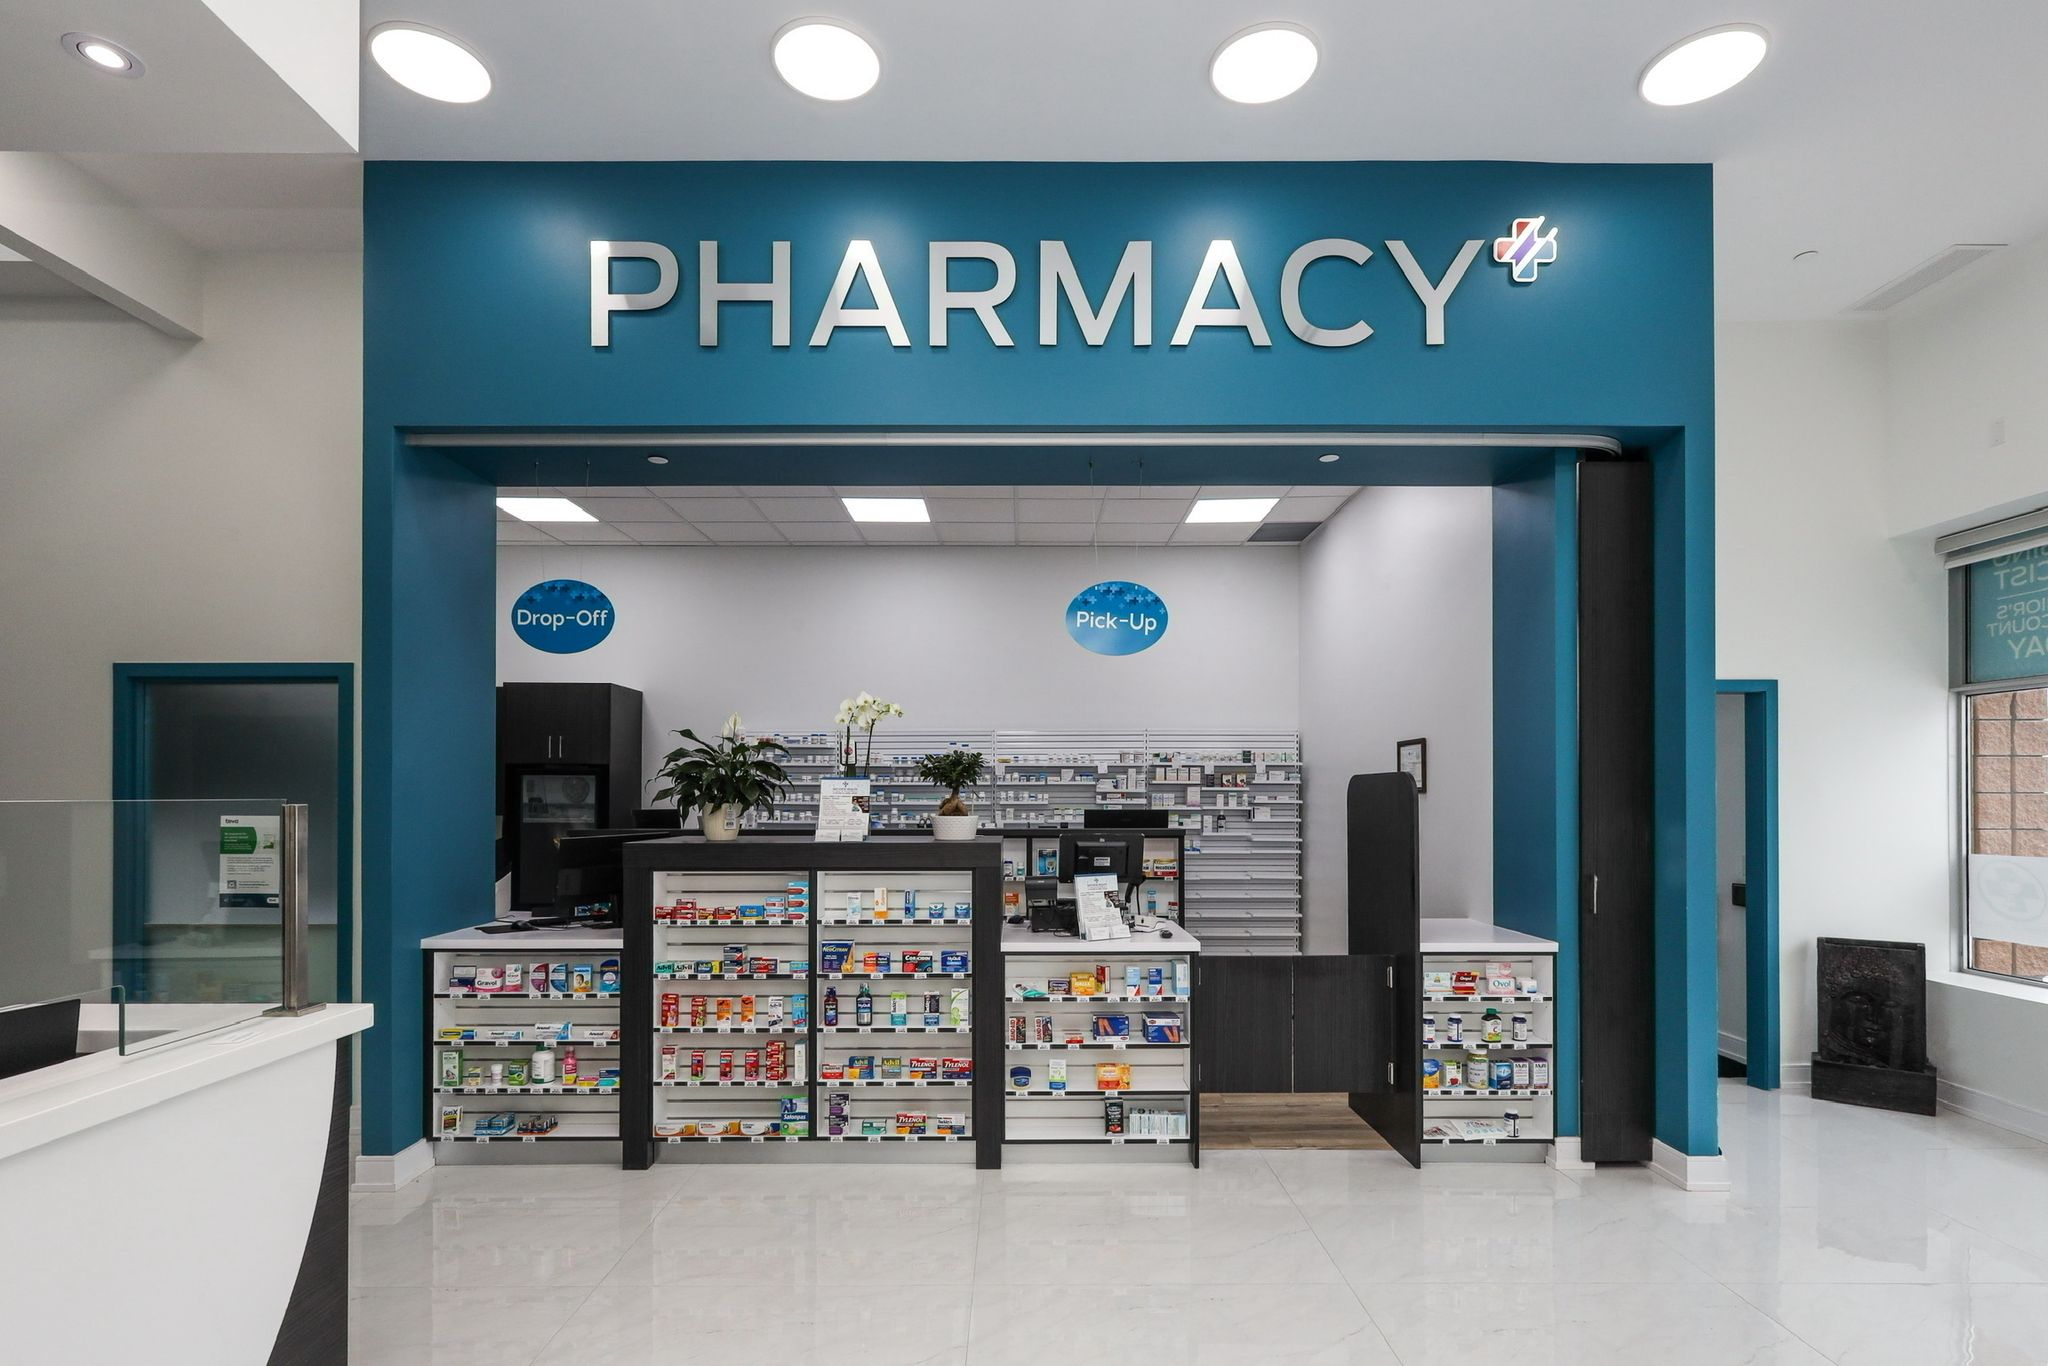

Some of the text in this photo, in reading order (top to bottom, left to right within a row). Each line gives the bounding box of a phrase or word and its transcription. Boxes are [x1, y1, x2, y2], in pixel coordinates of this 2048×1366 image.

[589, 239, 1484, 348] PHARMACY
[517, 609, 608, 631] Drop-Off
[1076, 611, 1157, 635] Pick-Up
